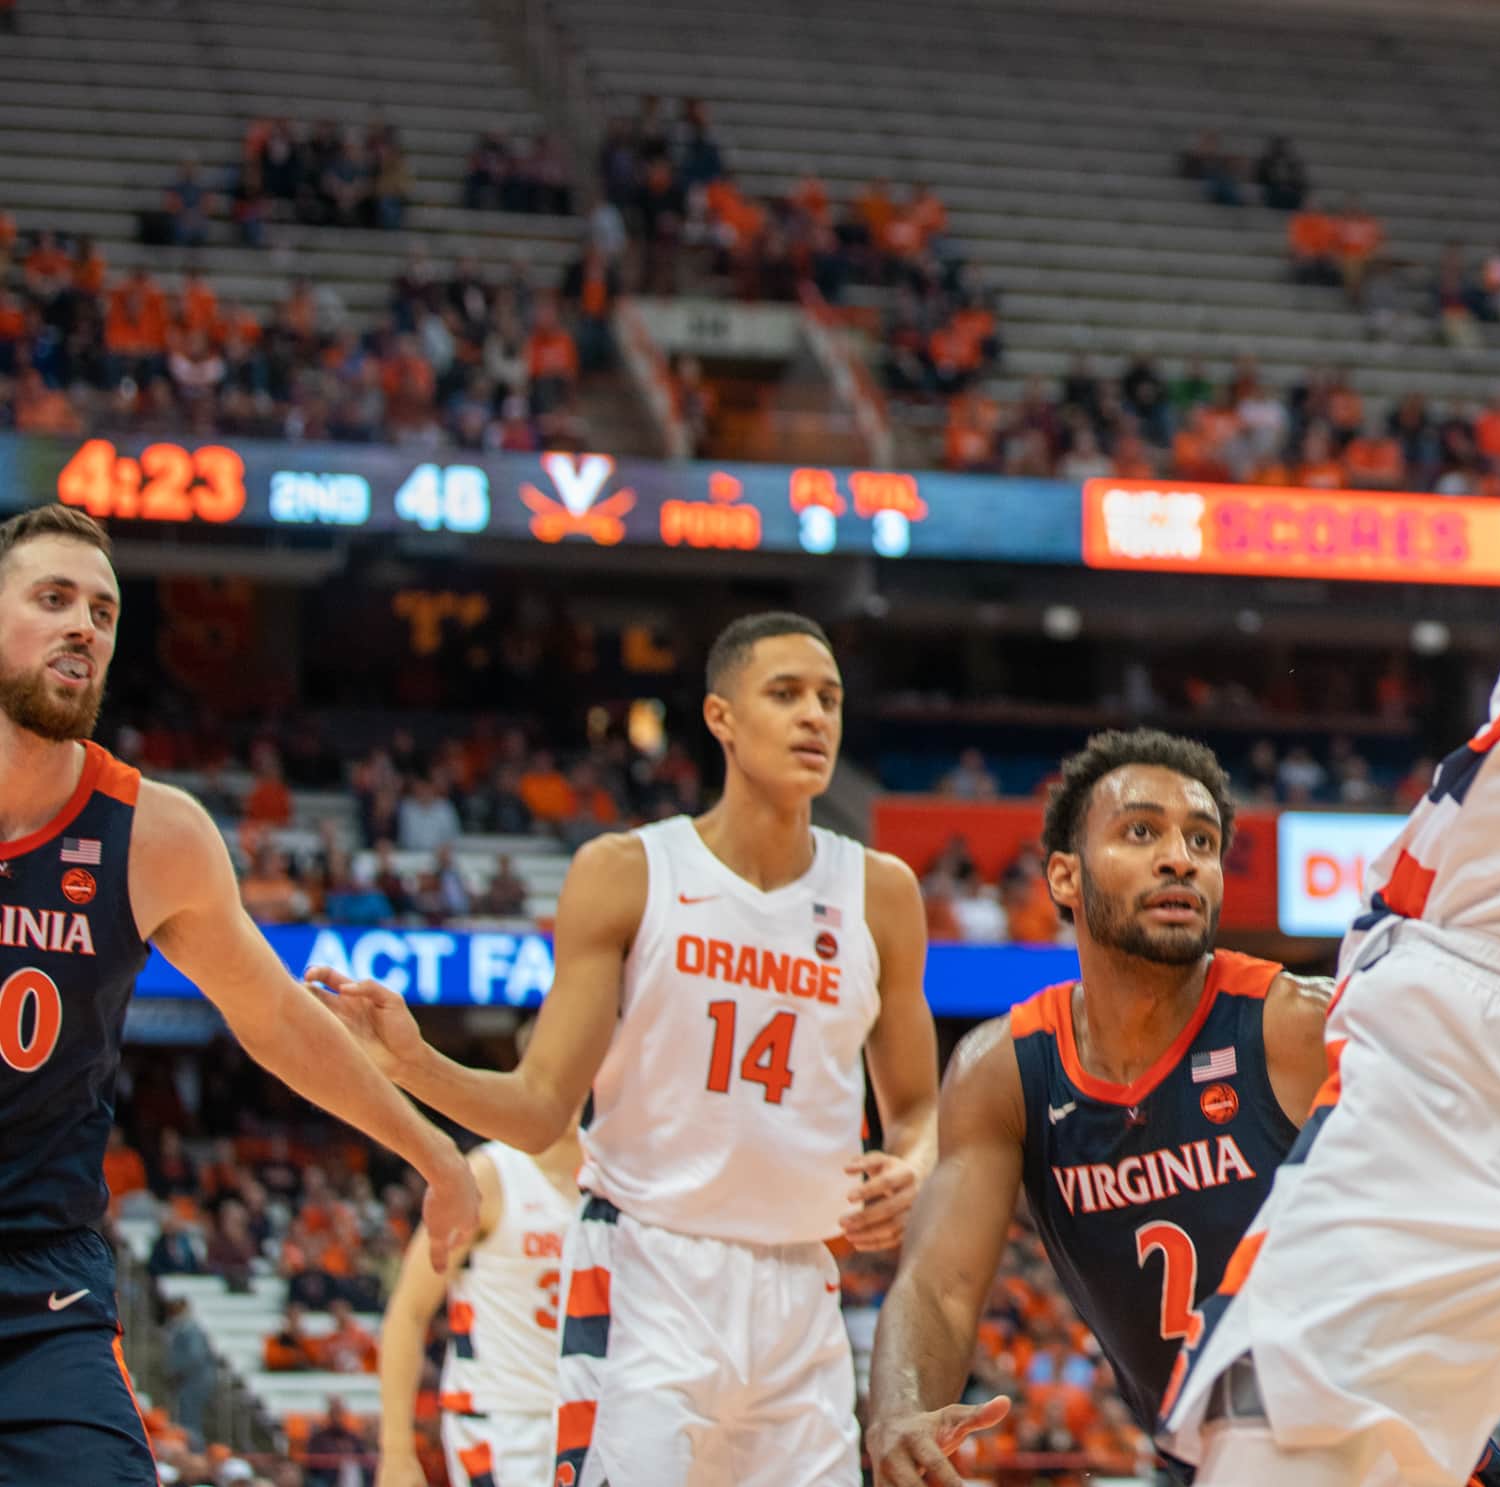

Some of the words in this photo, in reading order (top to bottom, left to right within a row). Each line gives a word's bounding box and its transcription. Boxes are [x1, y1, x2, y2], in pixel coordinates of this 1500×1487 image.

[58, 438, 247, 523] 4:23
[269, 471, 371, 526] 2ND
[676, 933, 841, 1006] ORANGE
[706, 998, 797, 1105] 14
[1052, 1134, 1257, 1217] VIRGINIA
[1134, 1218, 1205, 1350] 2
